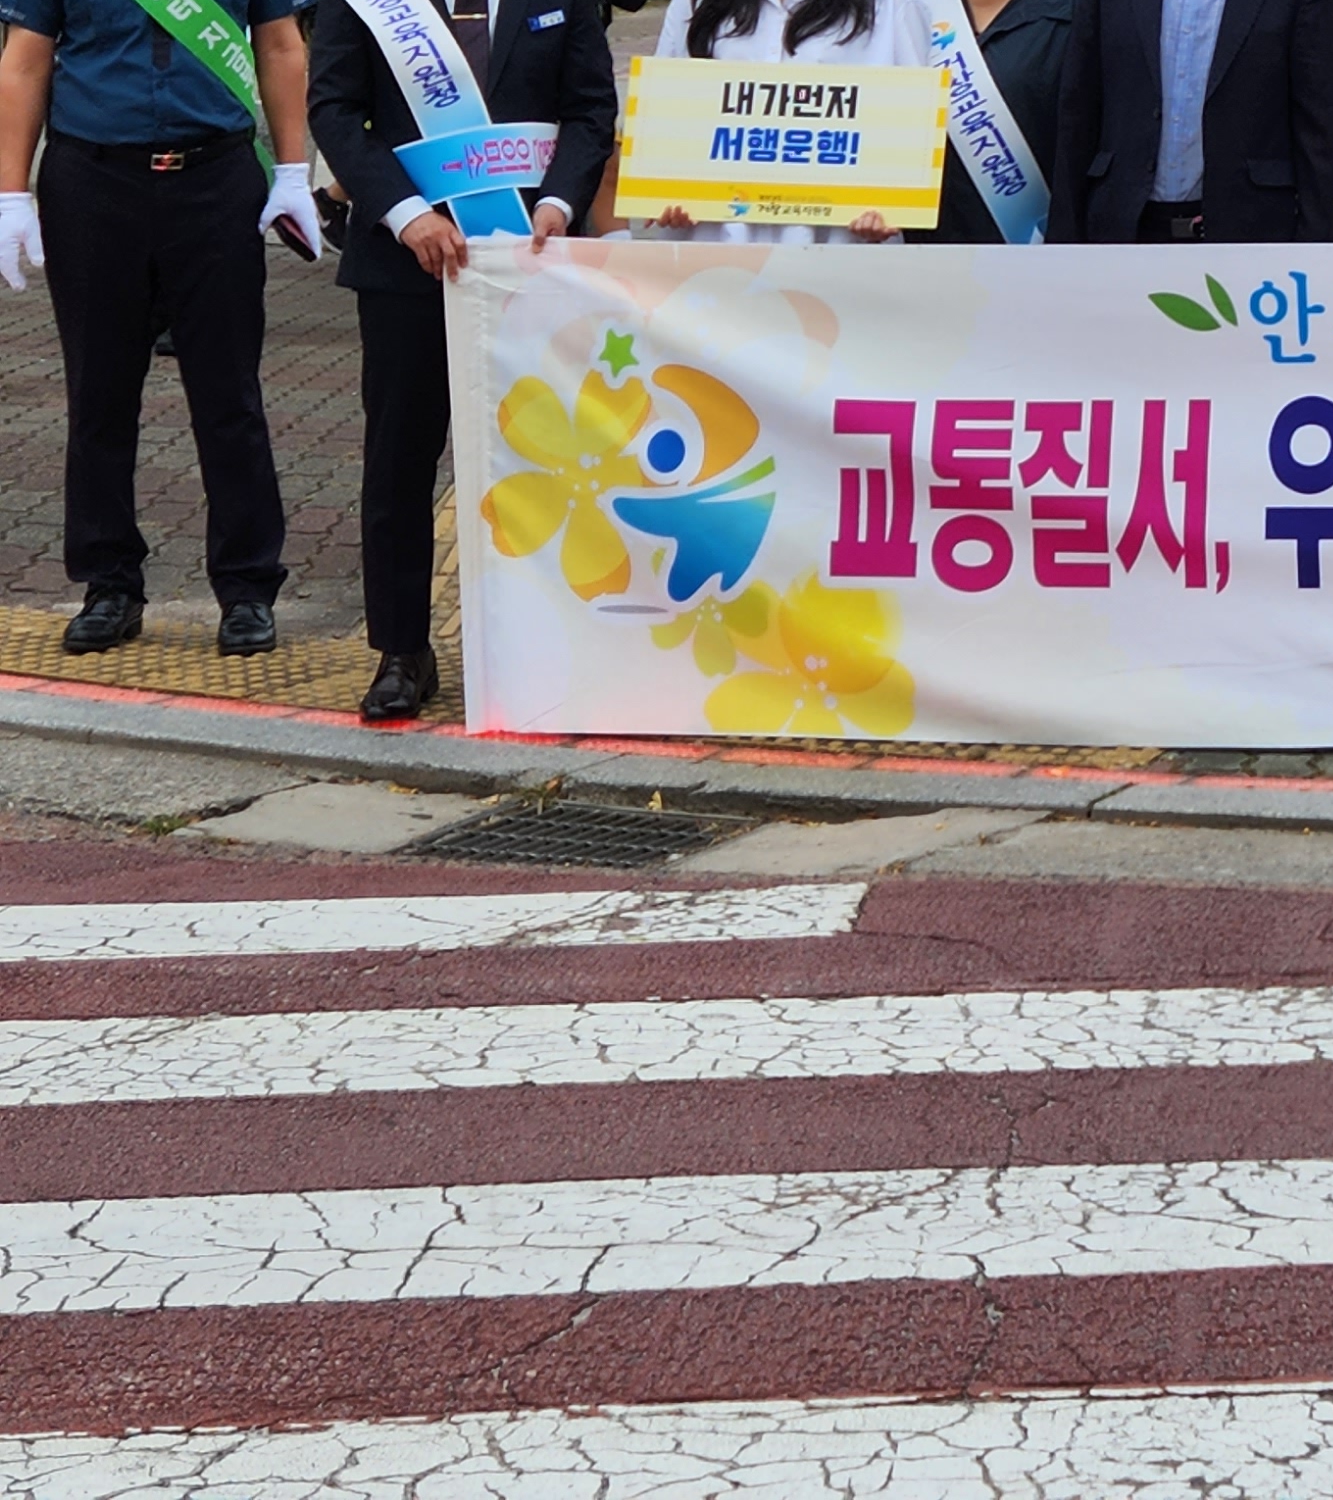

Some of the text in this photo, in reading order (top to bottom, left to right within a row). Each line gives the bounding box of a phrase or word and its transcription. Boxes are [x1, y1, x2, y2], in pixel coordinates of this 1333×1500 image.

[198, 21, 261, 104] 지금부
[721, 81, 859, 118] 내가먼저
[710, 127, 859, 165] 서행운행!
[829, 396, 1231, 595] 교통질서,
